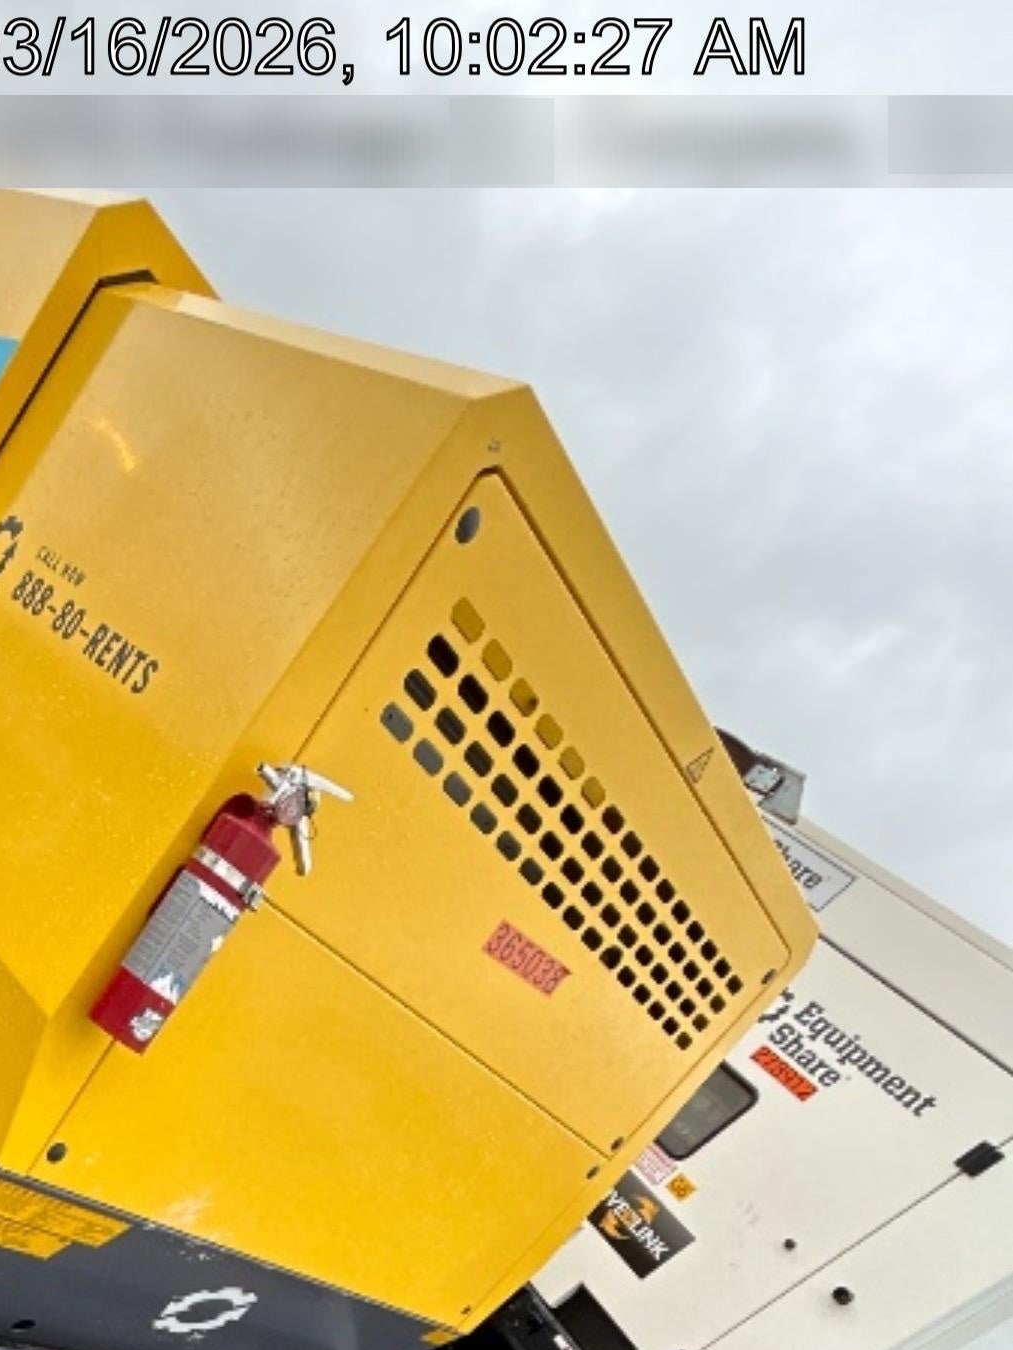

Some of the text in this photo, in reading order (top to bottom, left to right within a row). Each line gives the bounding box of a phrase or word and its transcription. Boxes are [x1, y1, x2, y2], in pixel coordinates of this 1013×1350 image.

[11, 570, 159, 694] 888-80-RENTS
[768, 1022, 841, 1087] Share
[794, 1000, 937, 1118] Equipment
